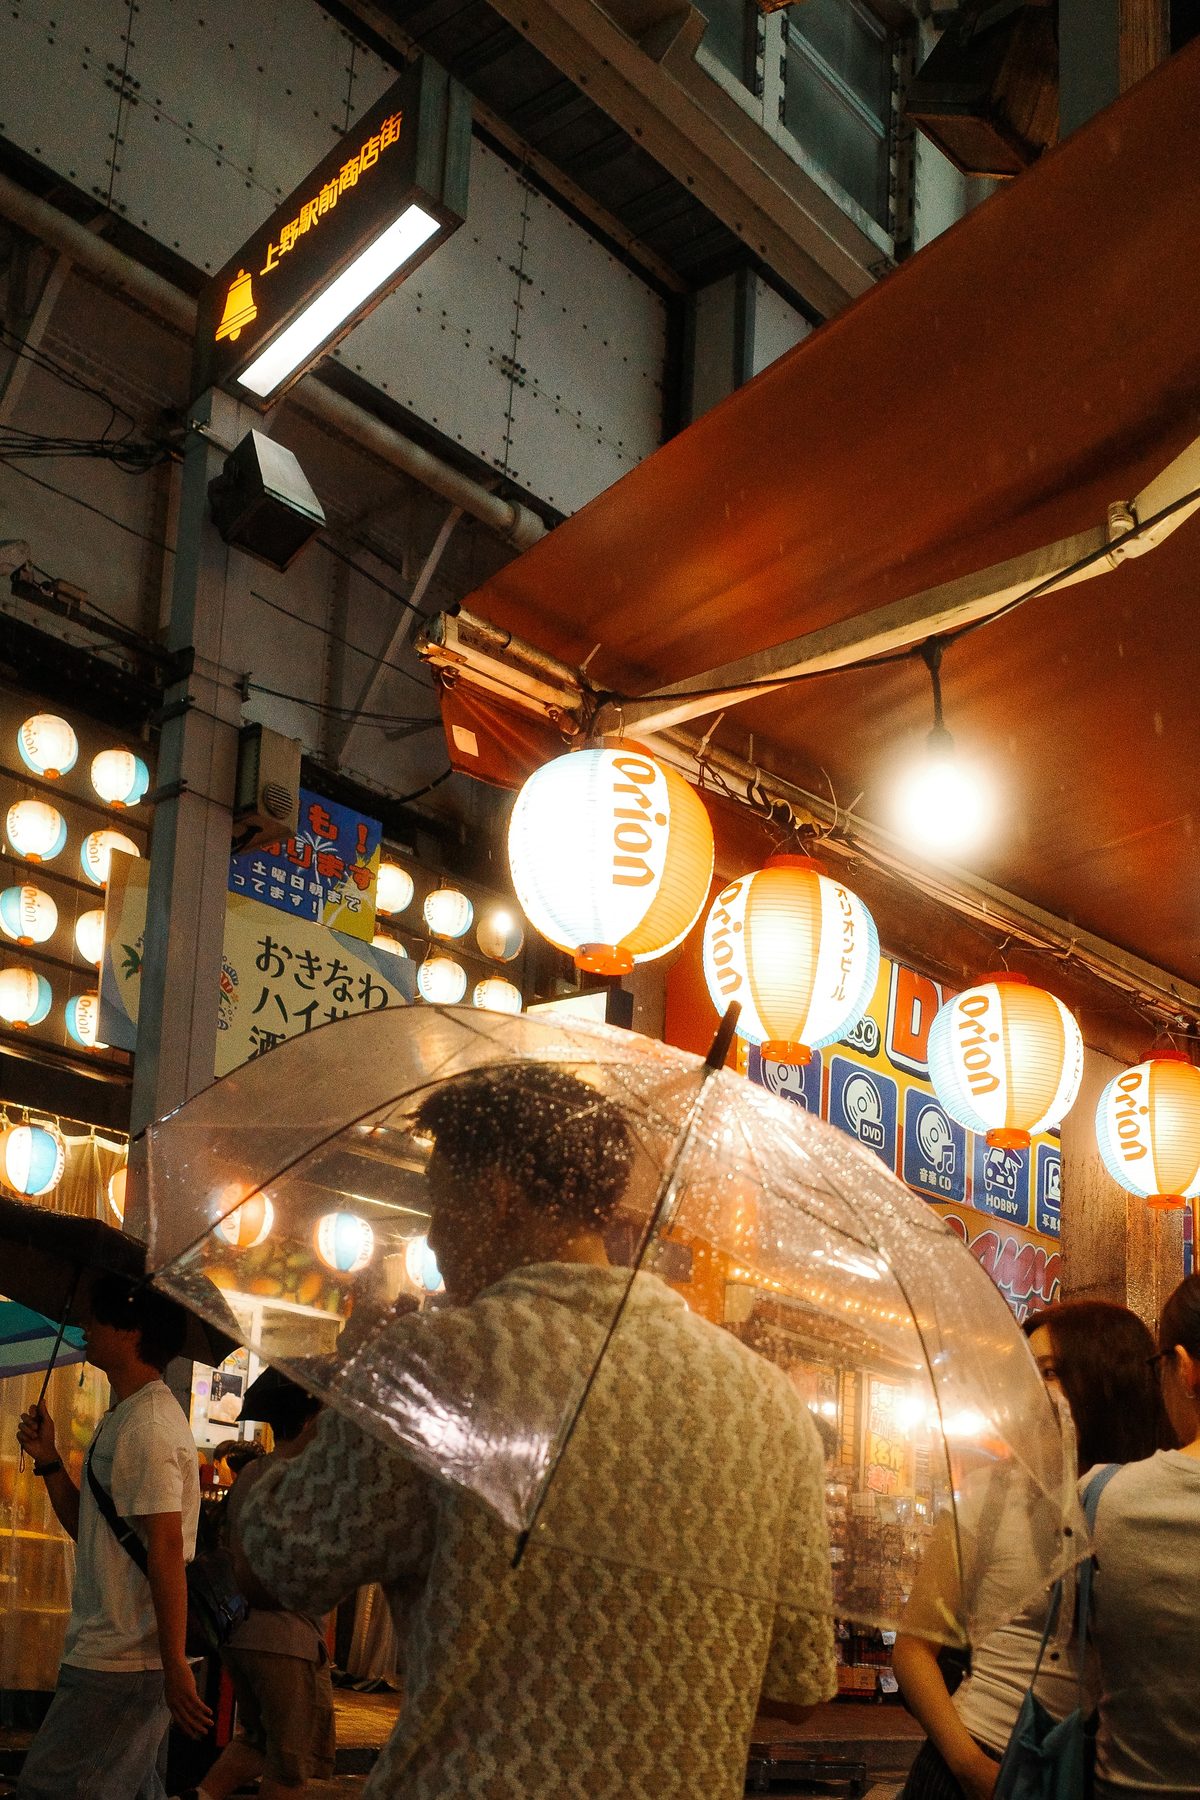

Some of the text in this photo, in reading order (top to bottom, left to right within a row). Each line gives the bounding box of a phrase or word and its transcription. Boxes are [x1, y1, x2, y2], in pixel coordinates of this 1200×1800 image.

[259, 111, 403, 276] 上野駅前商店街
[612, 757, 667, 887] Orion
[24, 889, 41, 923] Orion
[712, 882, 743, 996] Orion
[831, 887, 854, 1001] オリオンビール
[255, 935, 389, 1010] おきなわ
[78, 999, 94, 1034] Orion
[958, 995, 1000, 1097] Orion
[862, 1124, 882, 1141] DVD
[1115, 1073, 1149, 1161] Orion
[938, 1175, 952, 1191] CD
[985, 1193, 1019, 1216] HOBBY
